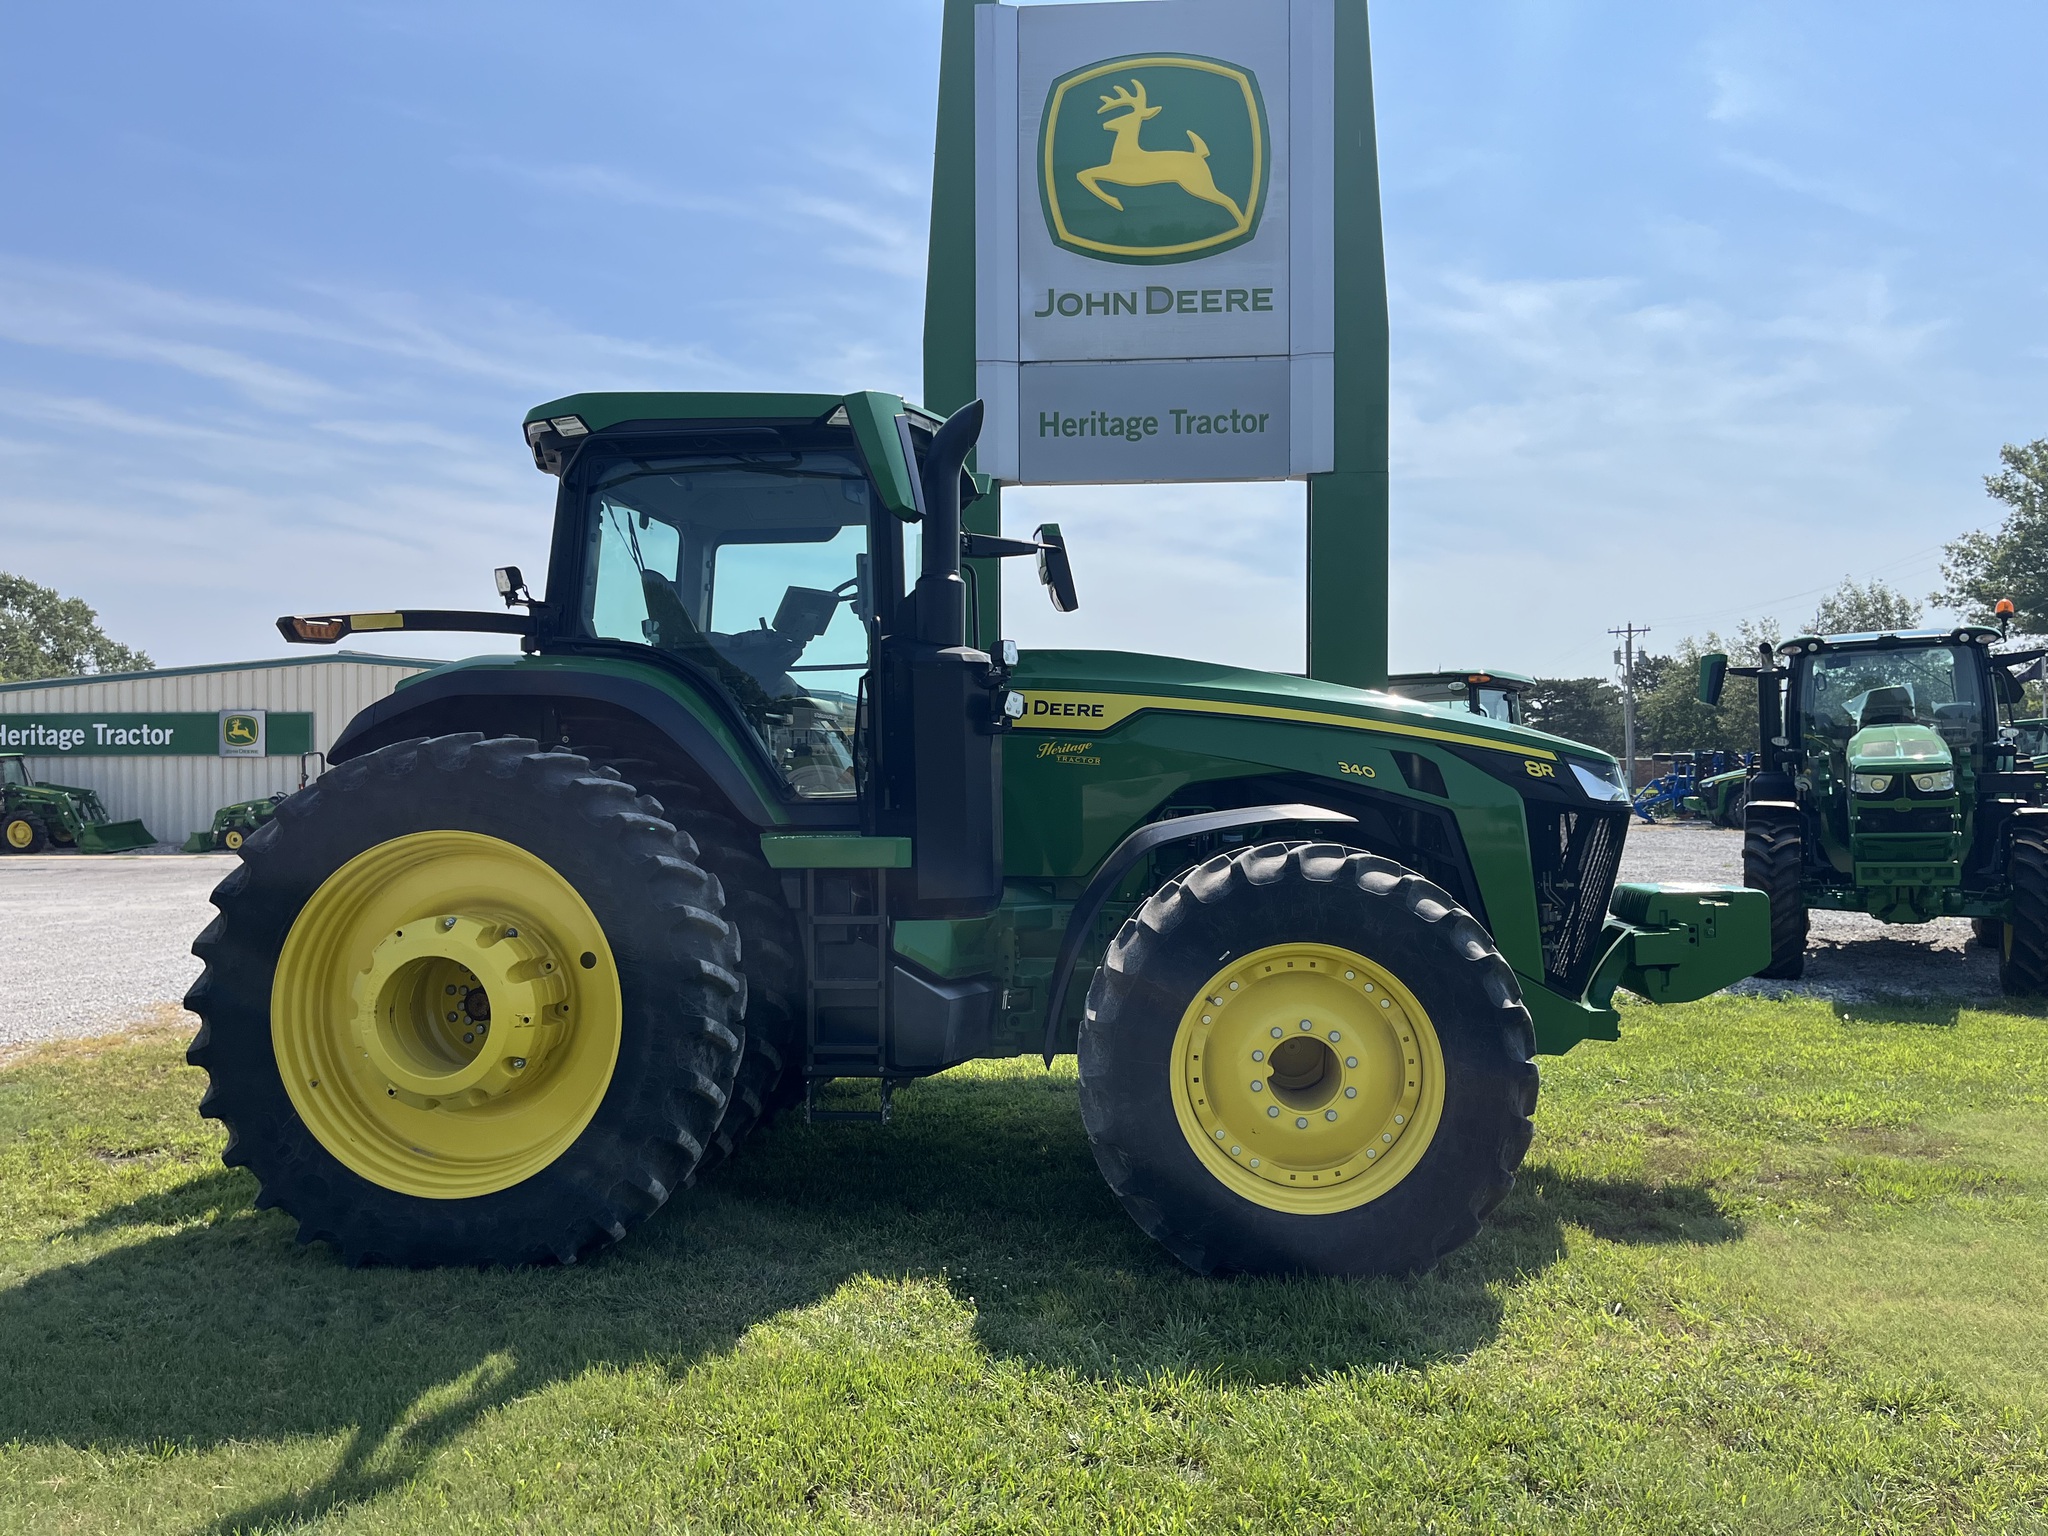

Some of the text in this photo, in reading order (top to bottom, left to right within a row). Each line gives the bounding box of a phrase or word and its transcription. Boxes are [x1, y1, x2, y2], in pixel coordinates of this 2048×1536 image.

[1034, 285, 1274, 318] JOHN DEERE
[1039, 408, 1270, 442] Heritage Tractor
[1033, 699, 1105, 717] DEERE
[92, 723, 174, 746] Tractor
[1036, 741, 1093, 759] Heritage
[1056, 756, 1101, 765] TRACTOR
[1337, 761, 1376, 778] 340
[1523, 760, 1556, 778] 8R
